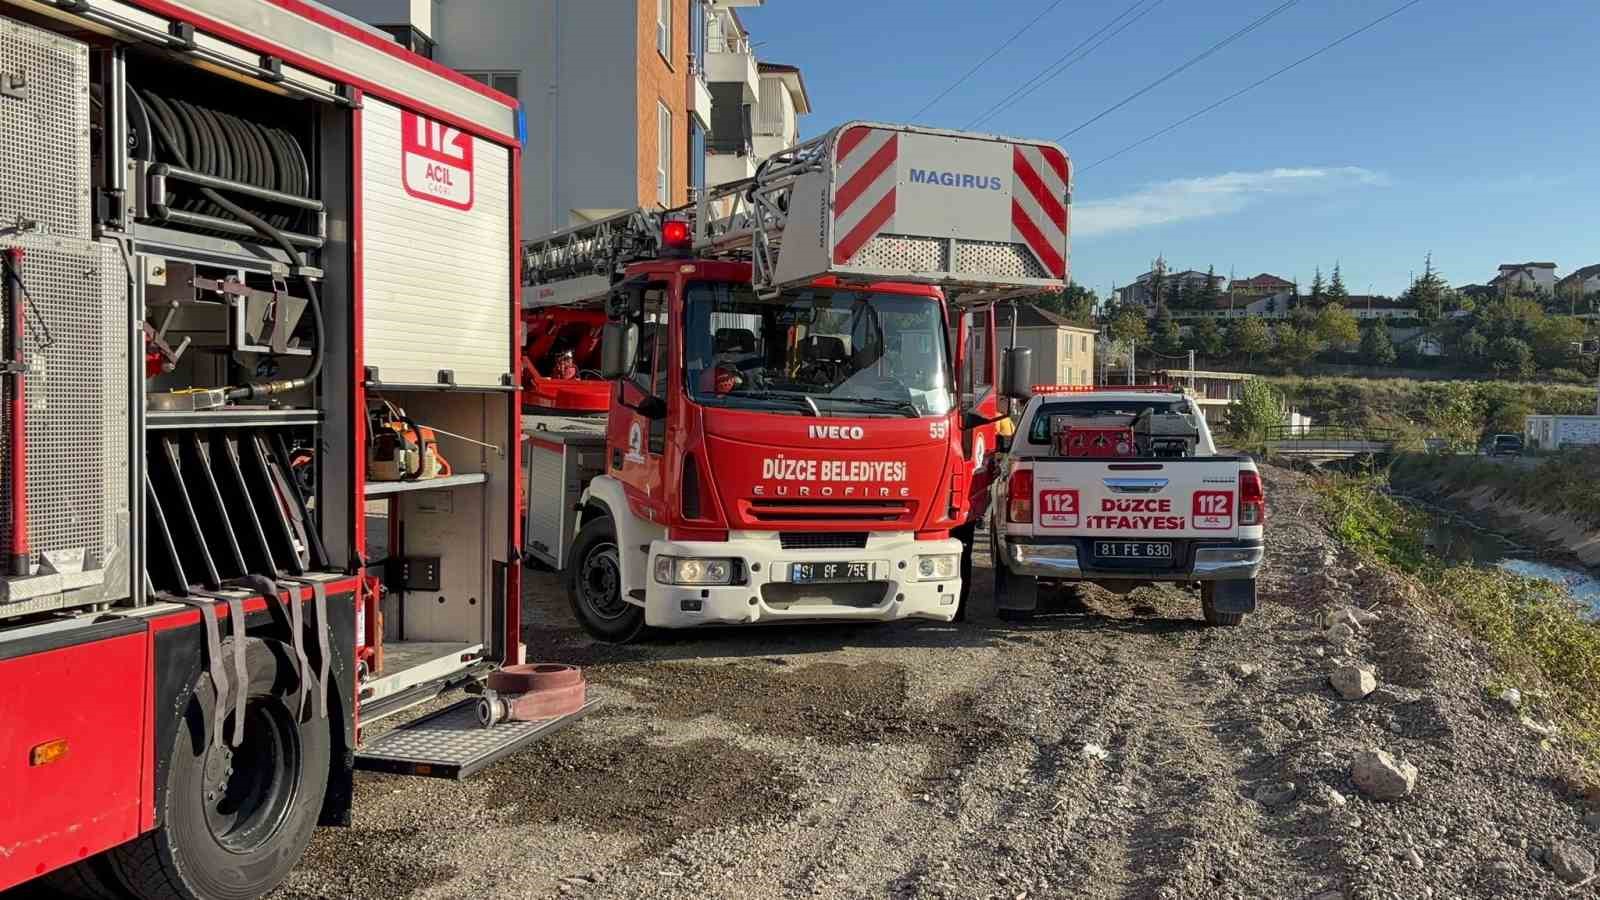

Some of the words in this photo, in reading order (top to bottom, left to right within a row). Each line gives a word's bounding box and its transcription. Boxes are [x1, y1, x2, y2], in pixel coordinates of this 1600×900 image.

[910, 168, 1001, 191] MAGIRUS
[808, 425, 864, 440] IVECO
[928, 422, 945, 439] 55
[762, 454, 817, 481] DÜZCE
[753, 485, 910, 497] EUROFIRE
[1044, 493, 1073, 512] 112
[1101, 498, 1171, 513] DÜZCE
[1198, 495, 1228, 514] 112
[1102, 543, 1116, 555] 81
[1124, 543, 1140, 556] FE
[1146, 543, 1170, 556] 630
